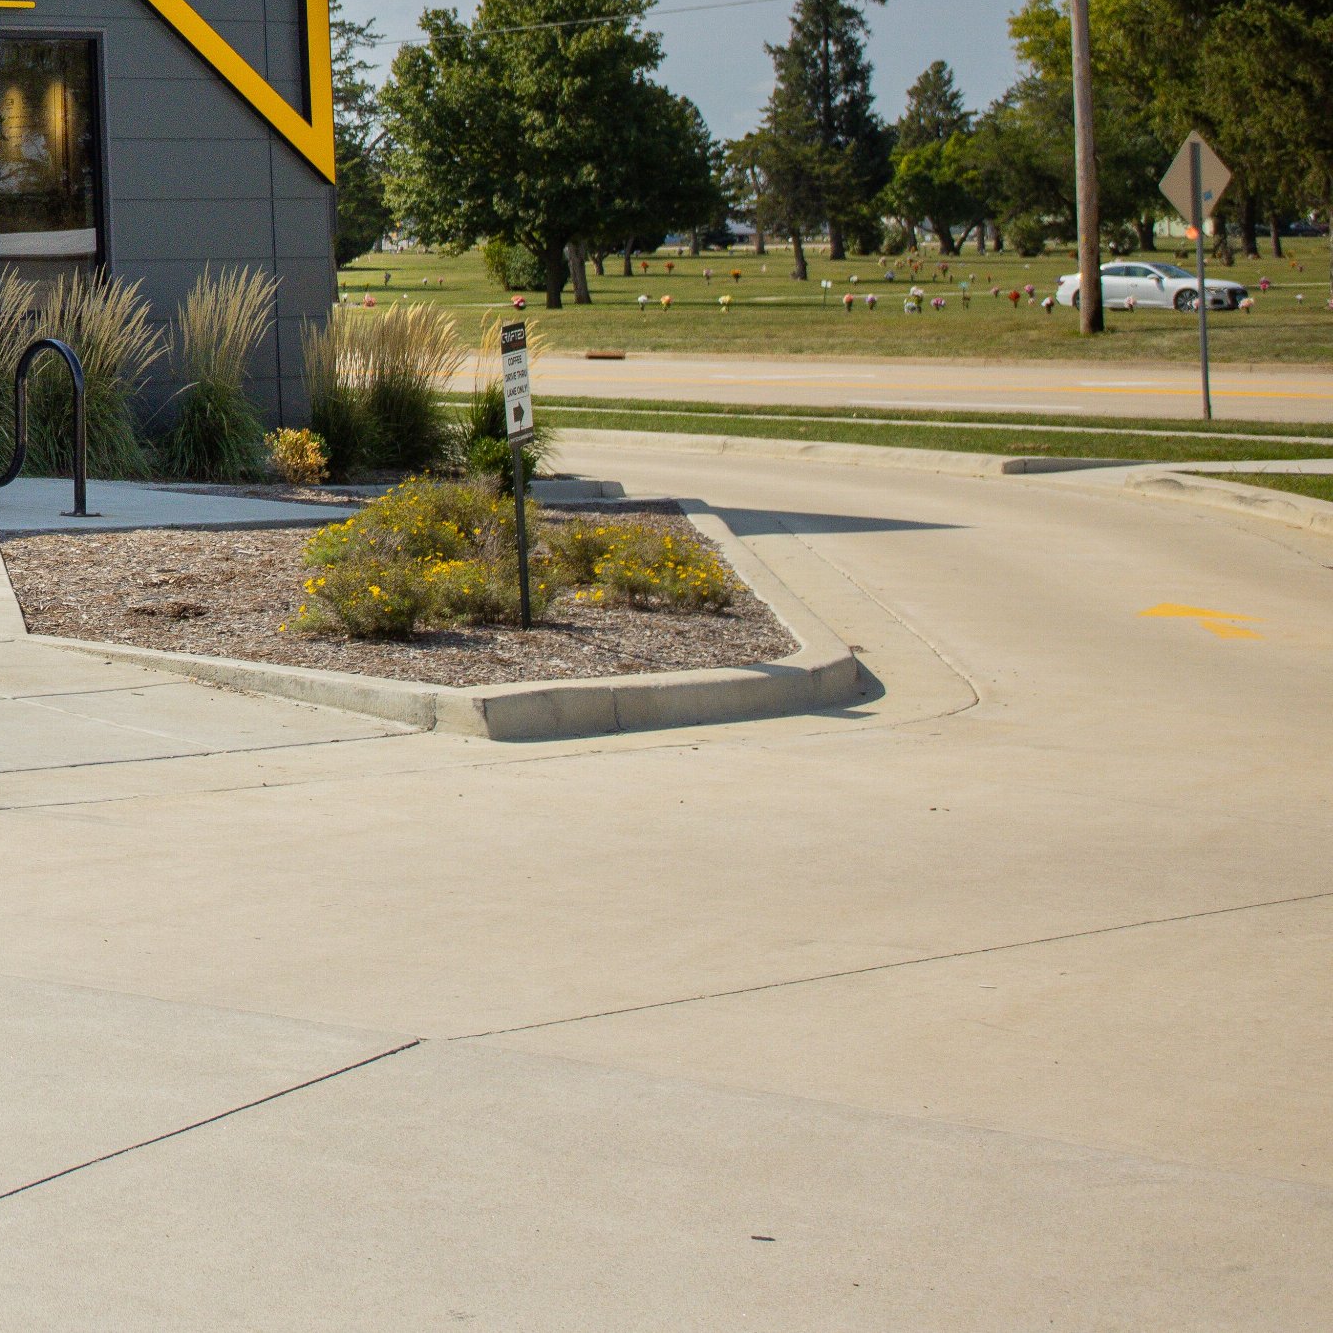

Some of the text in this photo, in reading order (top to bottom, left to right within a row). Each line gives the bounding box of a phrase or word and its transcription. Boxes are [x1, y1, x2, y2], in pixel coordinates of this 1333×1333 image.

[501, 328, 525, 344] CRAFTED
[507, 355, 523, 366] COFFEE
[505, 372, 517, 382] DRIVE
[507, 384, 528, 397] LANE ONLY
